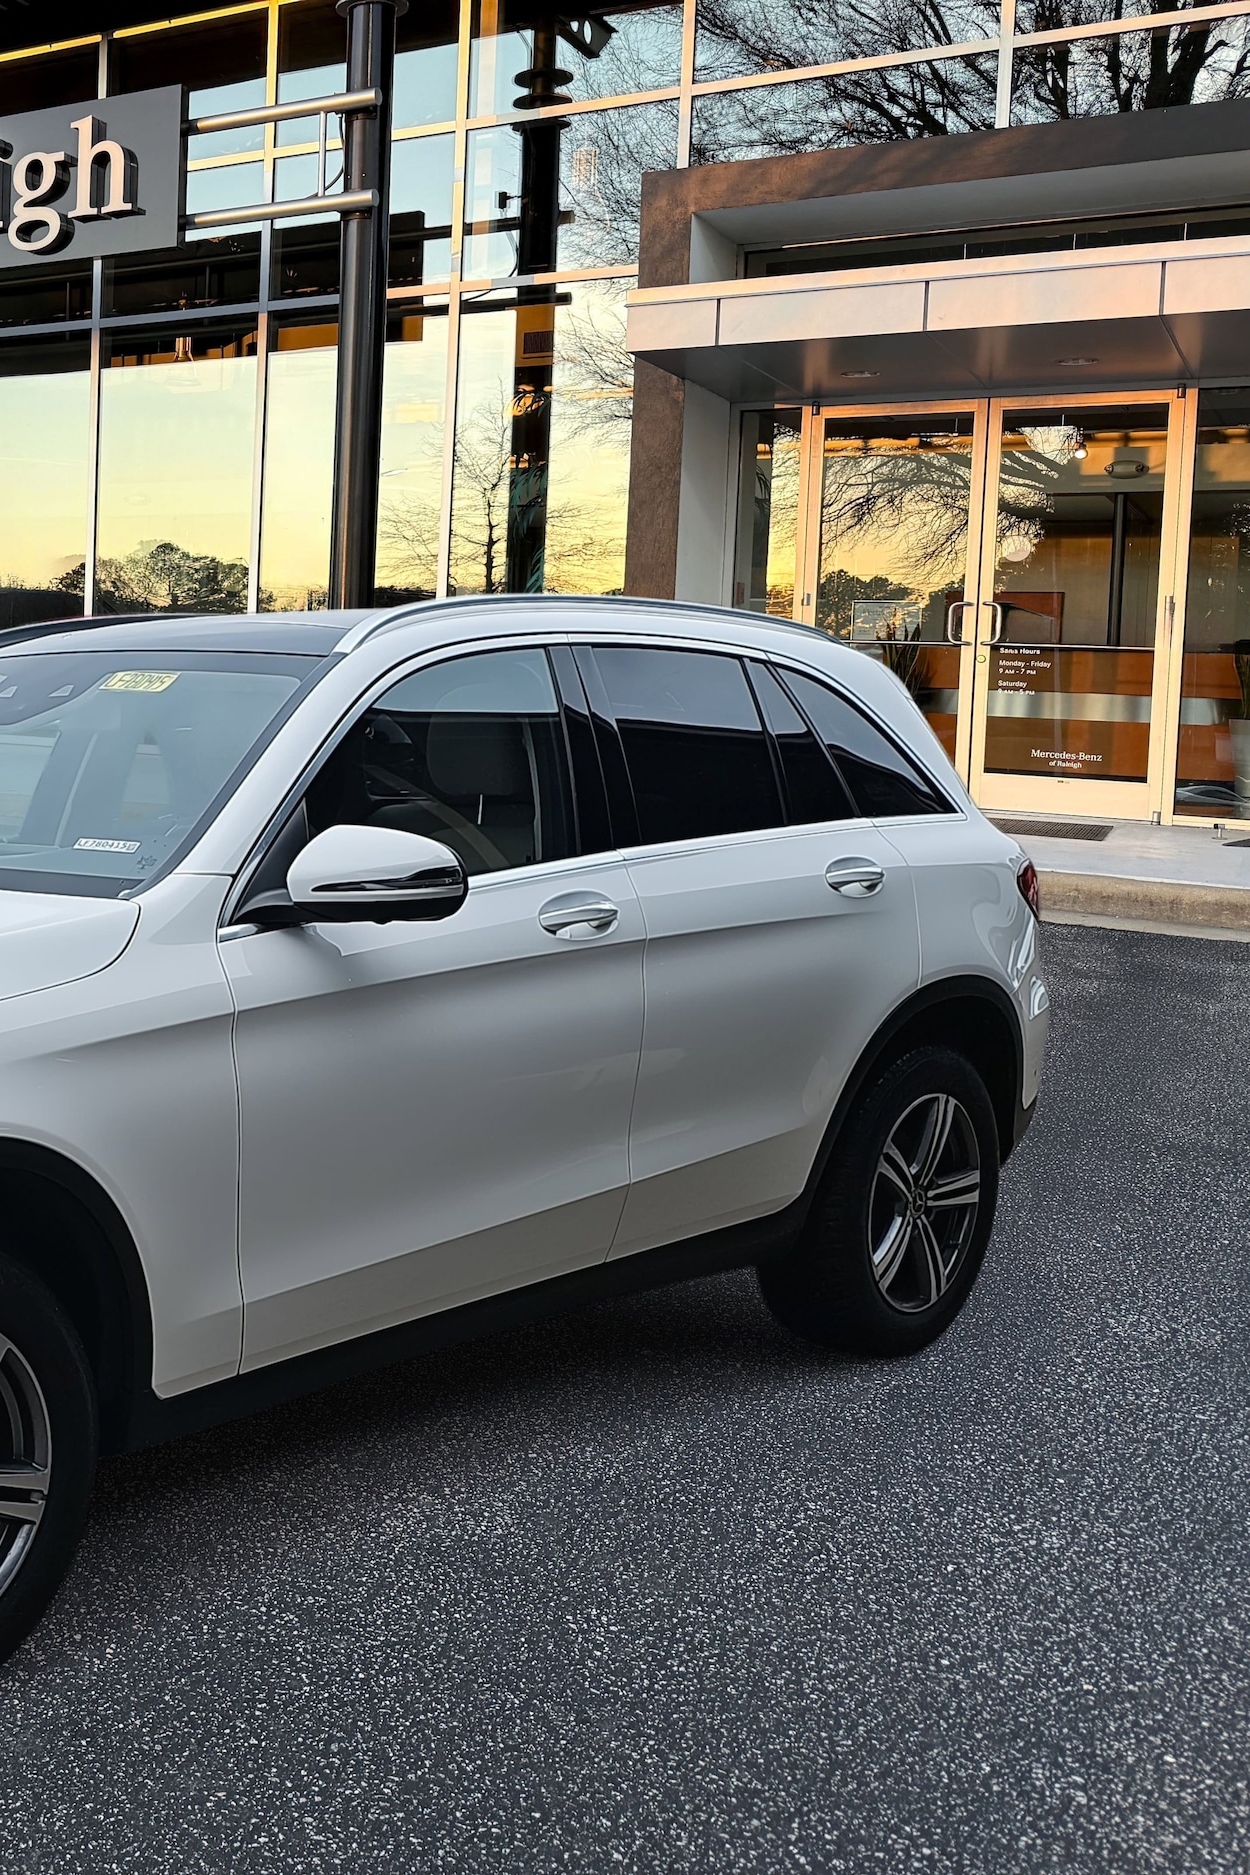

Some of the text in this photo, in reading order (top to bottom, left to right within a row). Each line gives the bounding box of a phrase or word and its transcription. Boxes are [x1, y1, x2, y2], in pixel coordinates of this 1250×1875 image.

[999, 659, 1025, 668] Monday
[1030, 660, 1052, 669] Friday
[997, 679, 1028, 689] Saturday
[1030, 749, 1103, 762] Mercedes-Benz
